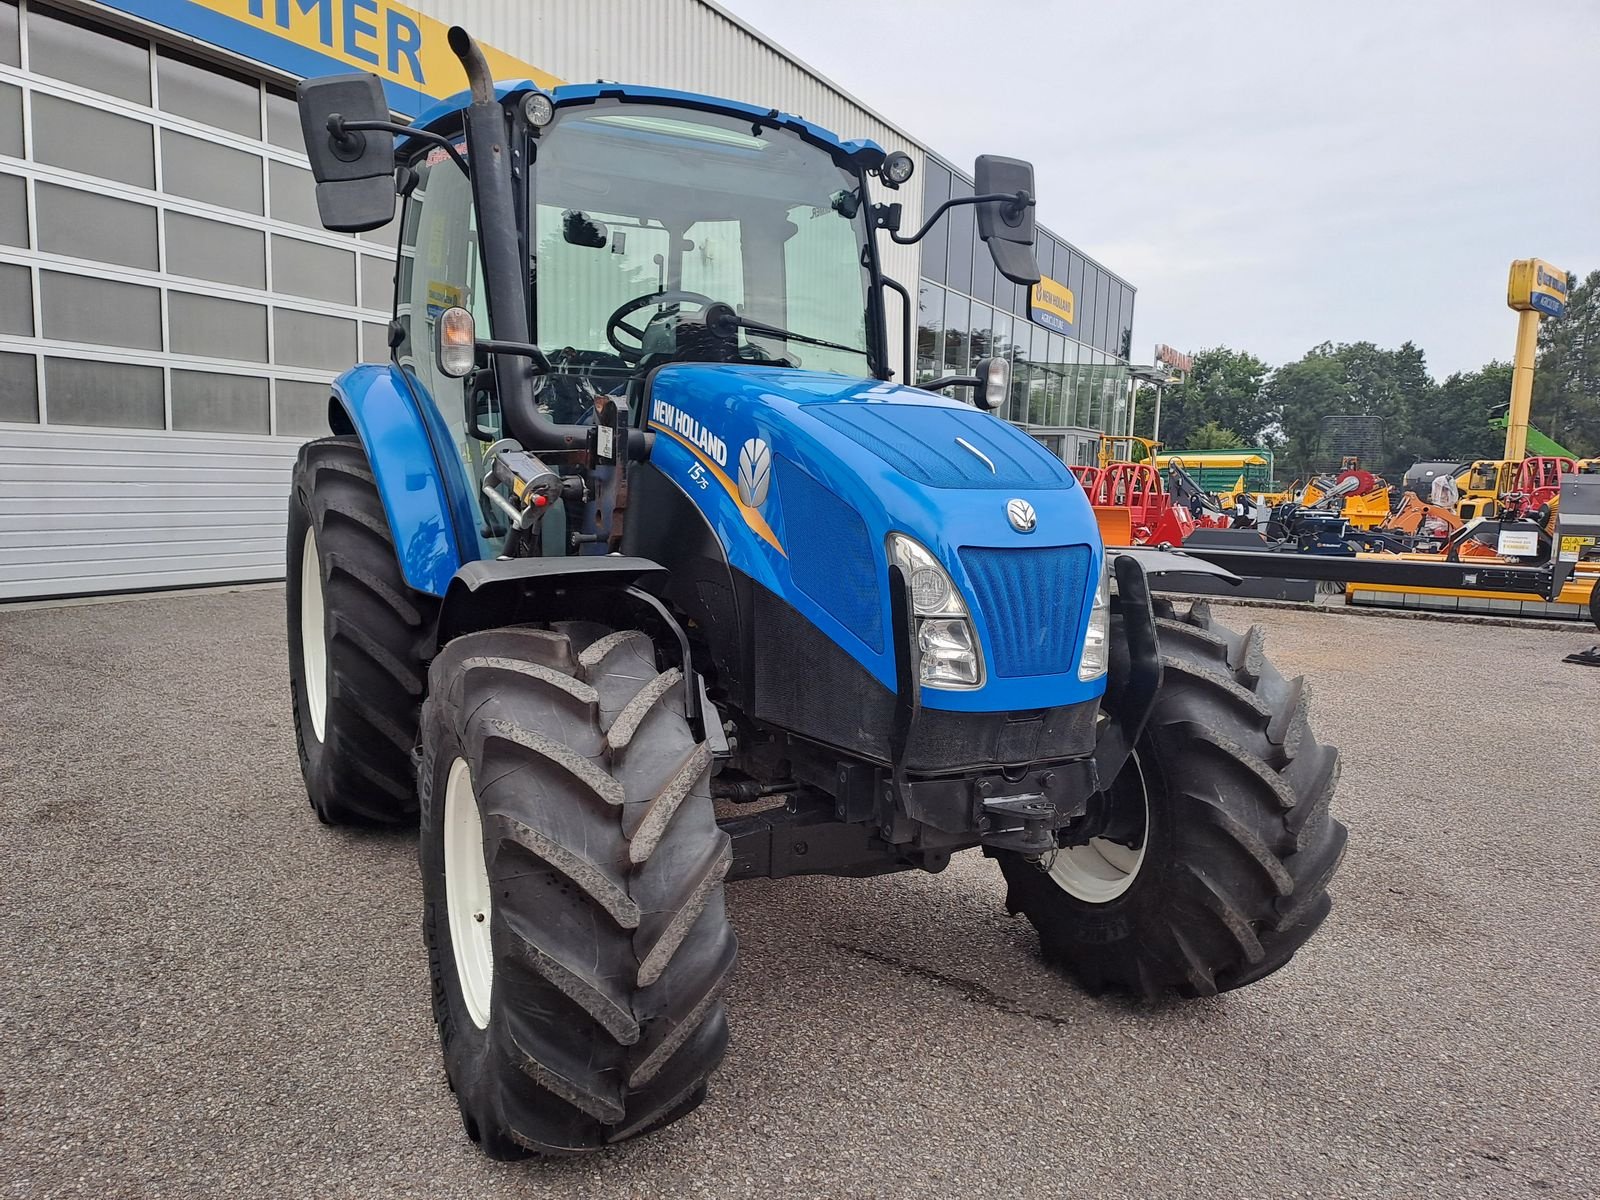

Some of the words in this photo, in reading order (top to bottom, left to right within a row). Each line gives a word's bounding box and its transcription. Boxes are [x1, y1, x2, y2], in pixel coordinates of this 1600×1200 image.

[248, 0, 426, 85] MER
[653, 399, 674, 427] NEW
[675, 408, 727, 467] HOLLAND
